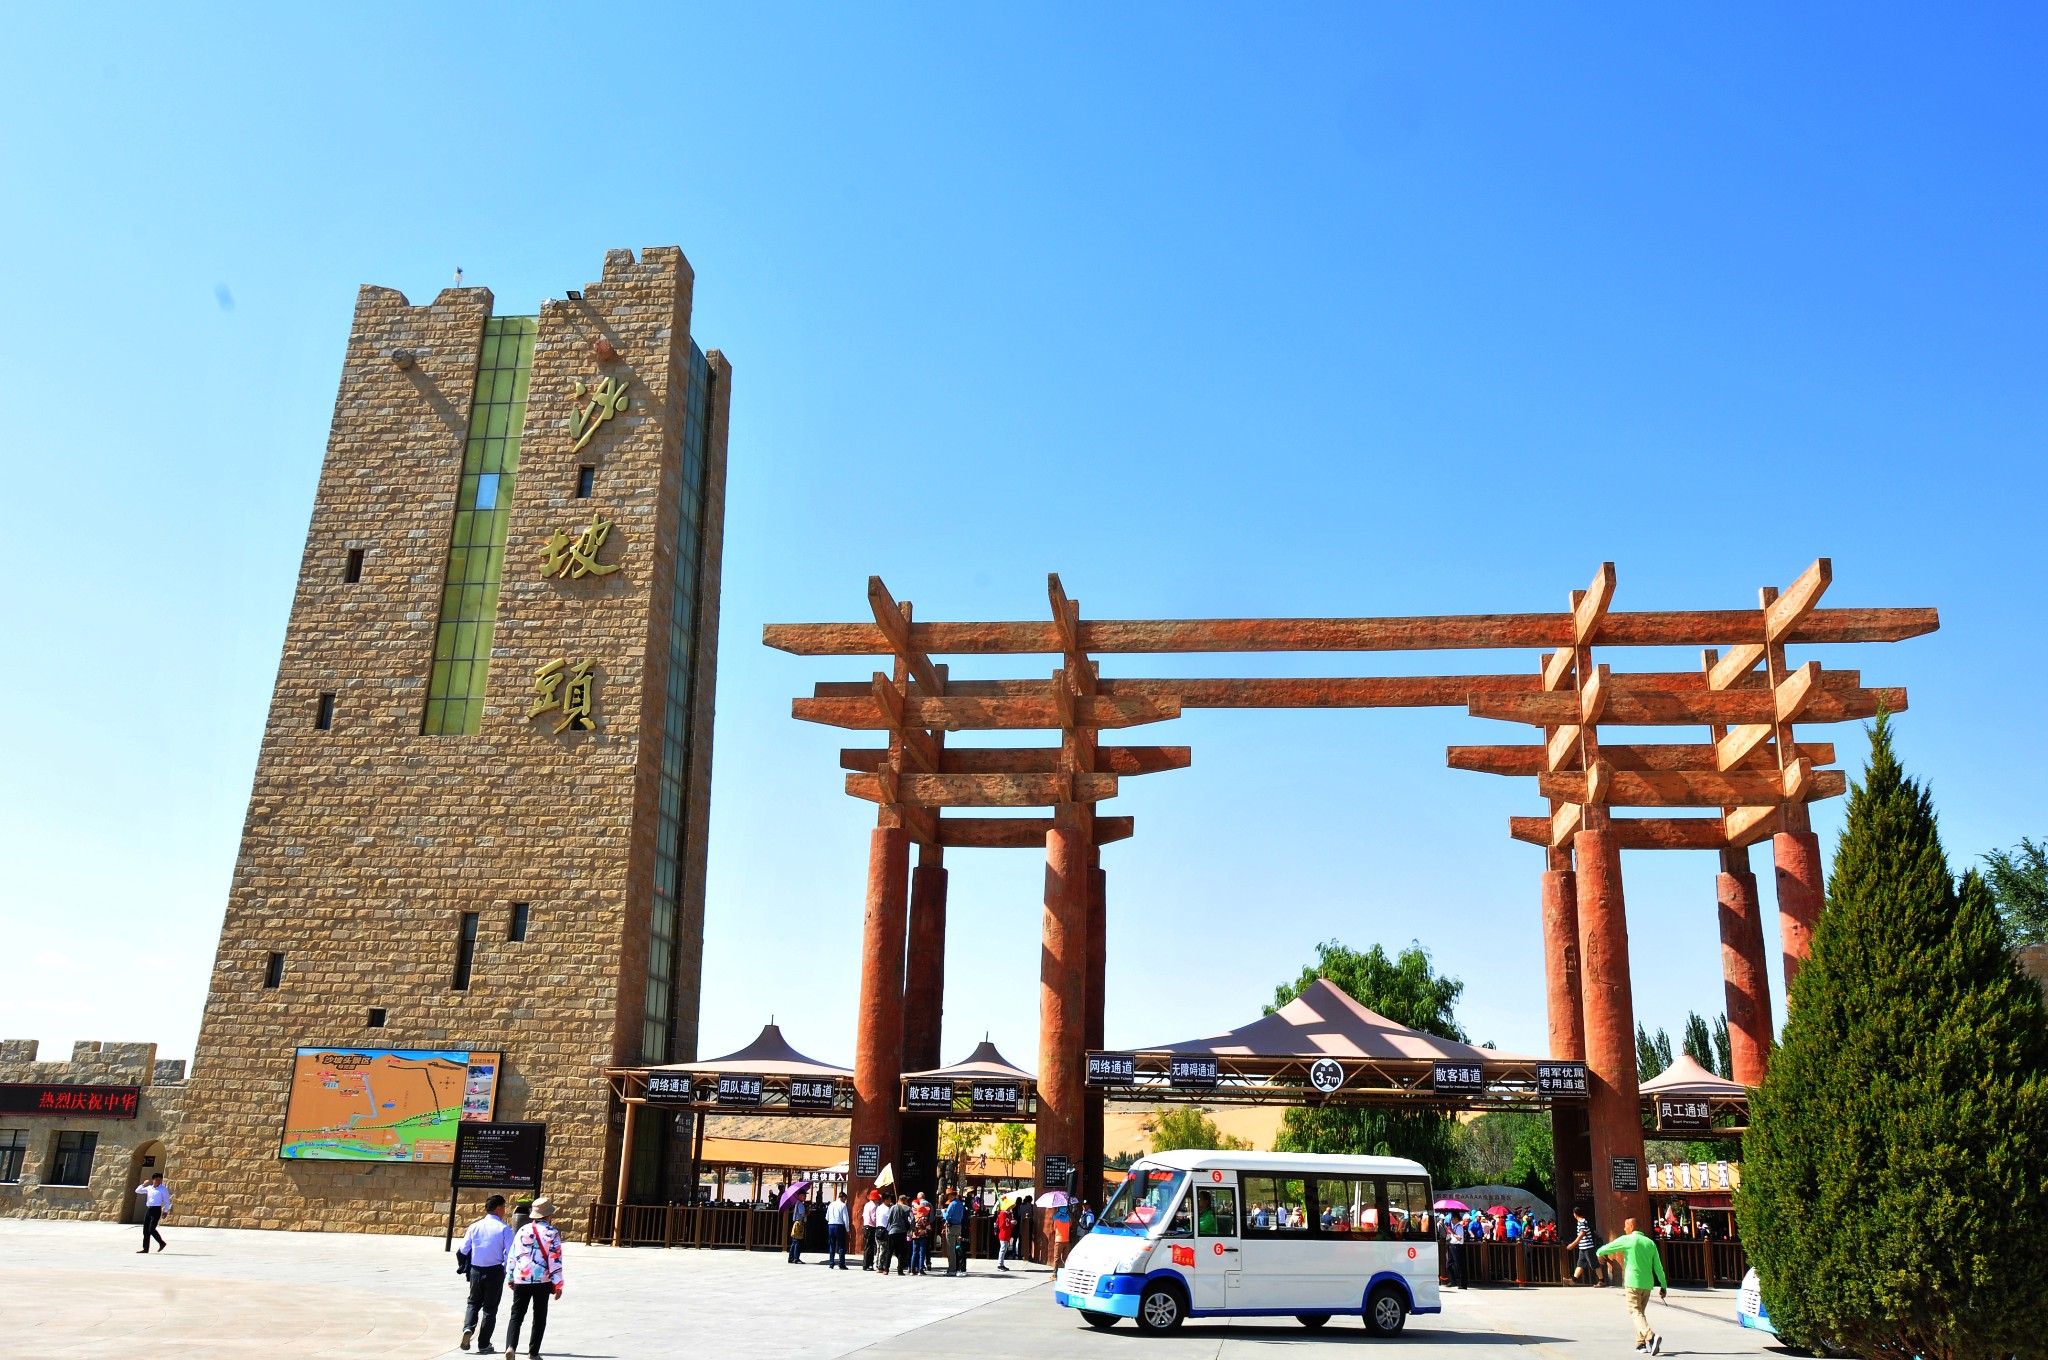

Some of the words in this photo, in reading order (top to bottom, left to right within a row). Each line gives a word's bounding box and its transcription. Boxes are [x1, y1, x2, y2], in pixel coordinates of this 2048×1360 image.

[1089, 1059, 1133, 1074] 网络通道
[1172, 1063, 1216, 1077] 无障碍通道
[1540, 1067, 1585, 1078] 拥军优属
[1316, 1071, 1340, 1085] 3.7m
[1435, 1068, 1482, 1083] 散客通道
[649, 1078, 690, 1093] 网络通道
[720, 1080, 761, 1095] 团队通道
[791, 1082, 833, 1098] 团队通道
[1540, 1078, 1586, 1090] 专用通道
[909, 1085, 952, 1101] 散客通道
[973, 1087, 1016, 1102] 散客通道
[39, 1091, 135, 1111] 热烈庆祝中华
[1661, 1102, 1709, 1118] 员工通道
